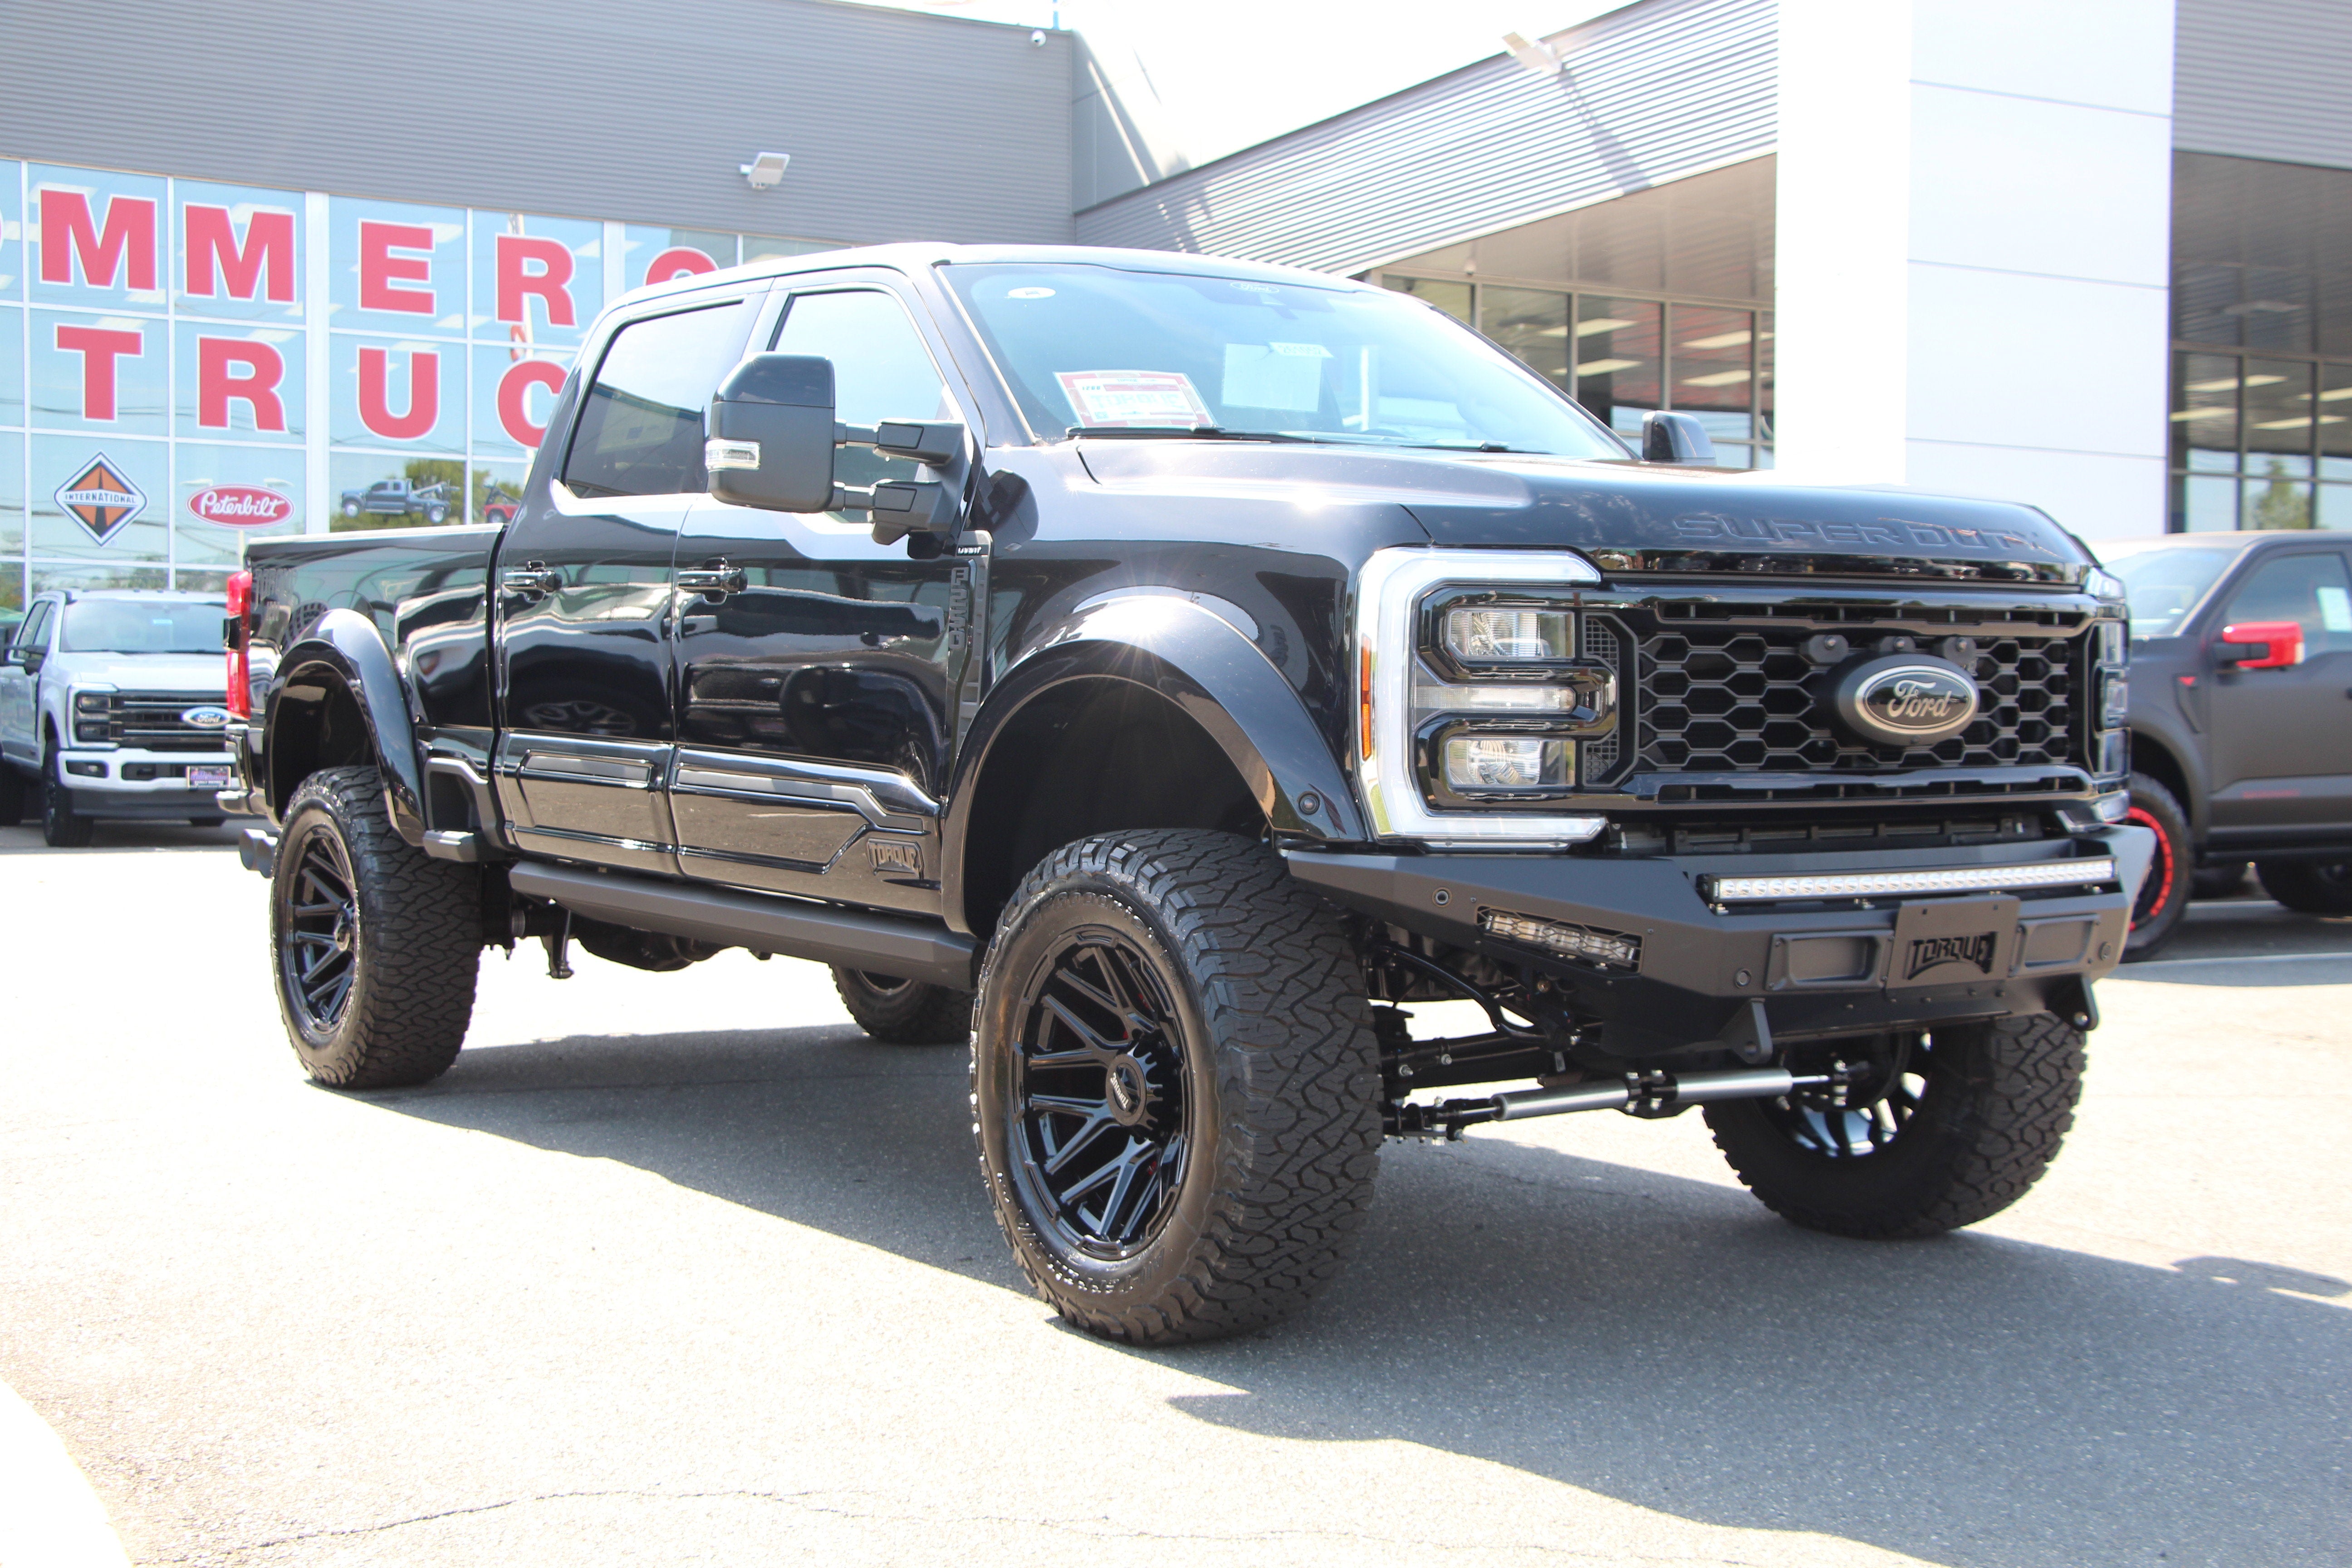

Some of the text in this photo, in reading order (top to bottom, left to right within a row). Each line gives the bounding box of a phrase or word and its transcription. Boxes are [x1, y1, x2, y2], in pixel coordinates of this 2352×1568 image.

[0, 190, 715, 325] MMER
[1240, 282, 1272, 292] Ford
[65, 491, 136, 504] INTERNATIONAL
[200, 490, 286, 518] Peterbilt
[1671, 514, 2042, 550] SUPER DUTY
[1886, 679, 1952, 718] Ford
[197, 713, 221, 723] Ford
[867, 842, 921, 877] TORQUE
[1907, 931, 1998, 980] TORQUE
[1110, 1072, 1129, 1109] TORQUE
